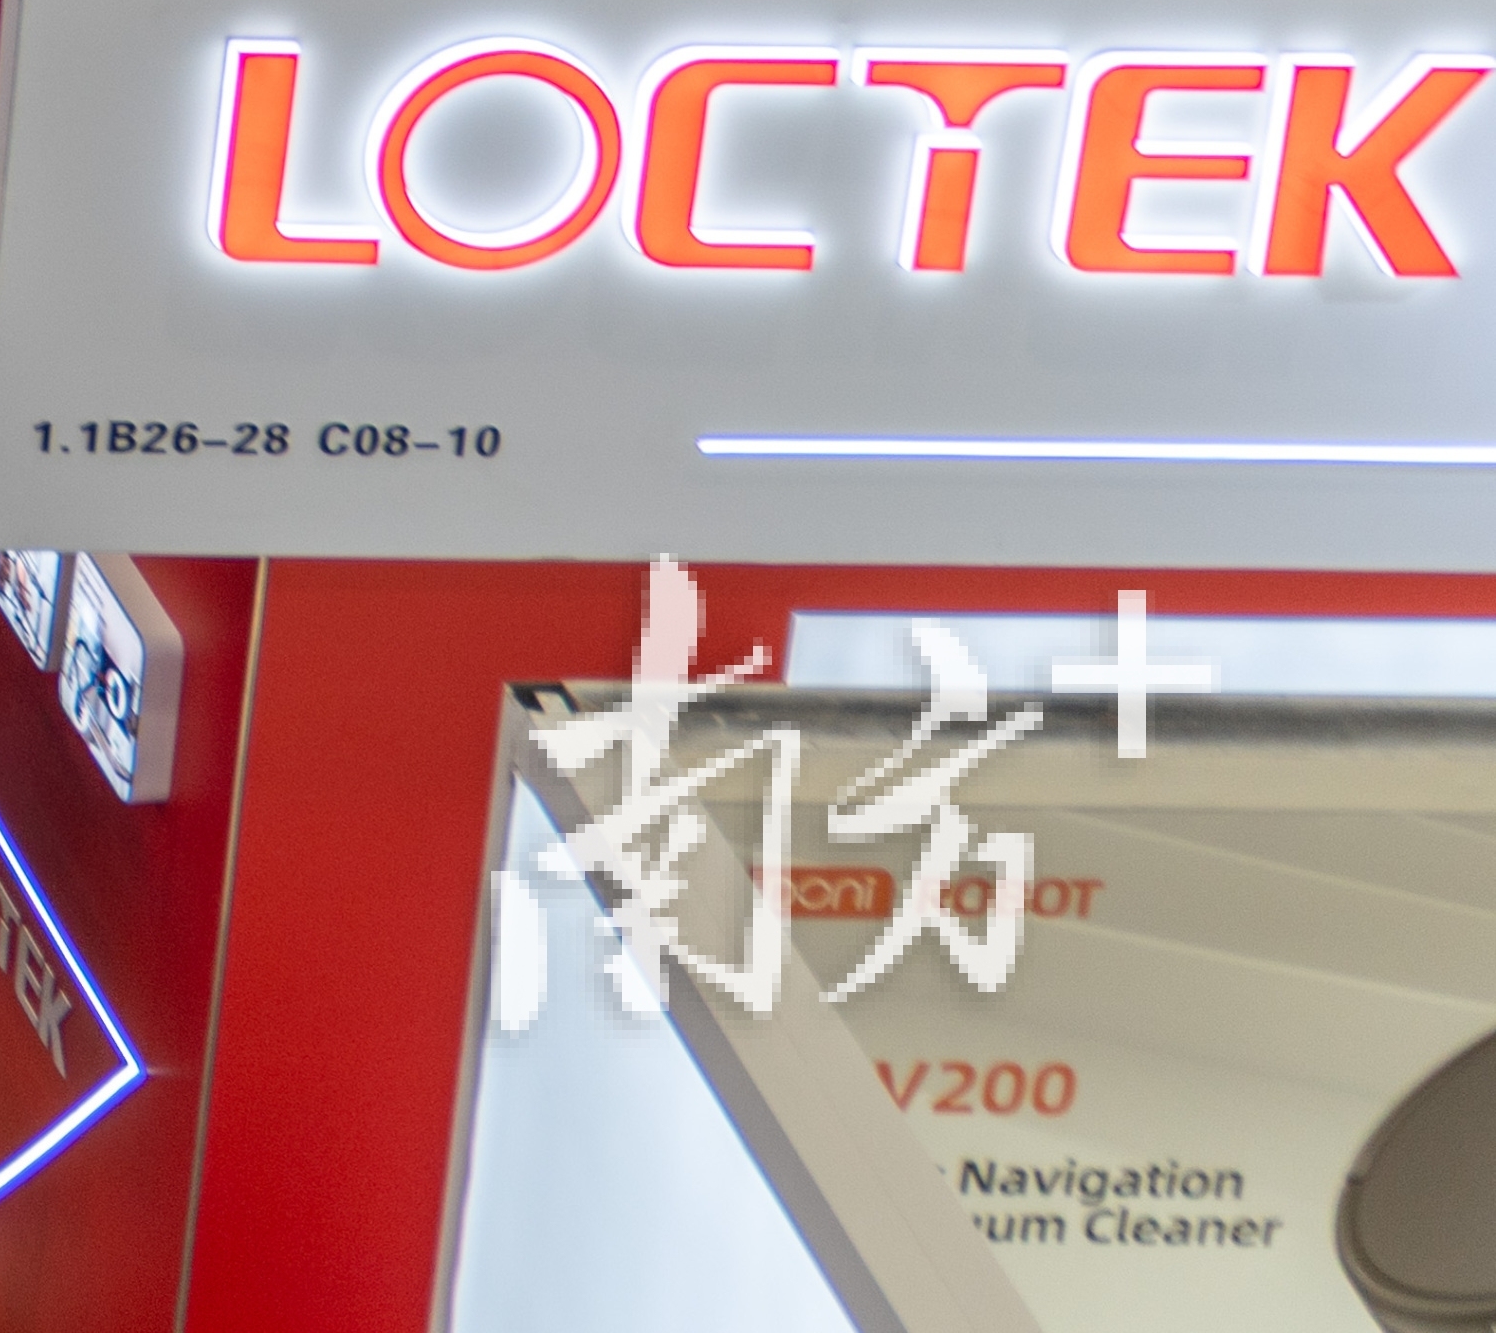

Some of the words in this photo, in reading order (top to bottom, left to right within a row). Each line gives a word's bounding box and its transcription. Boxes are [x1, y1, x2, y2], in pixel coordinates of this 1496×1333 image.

[208, 36, 1496, 280] LOCTEK
[30, 419, 293, 459] 1.1B26-28
[316, 422, 506, 461] C08-10
[958, 1159, 1247, 1206] Navigation
[972, 1209, 1067, 1246] um
[1085, 1207, 1282, 1250] Cleaner
